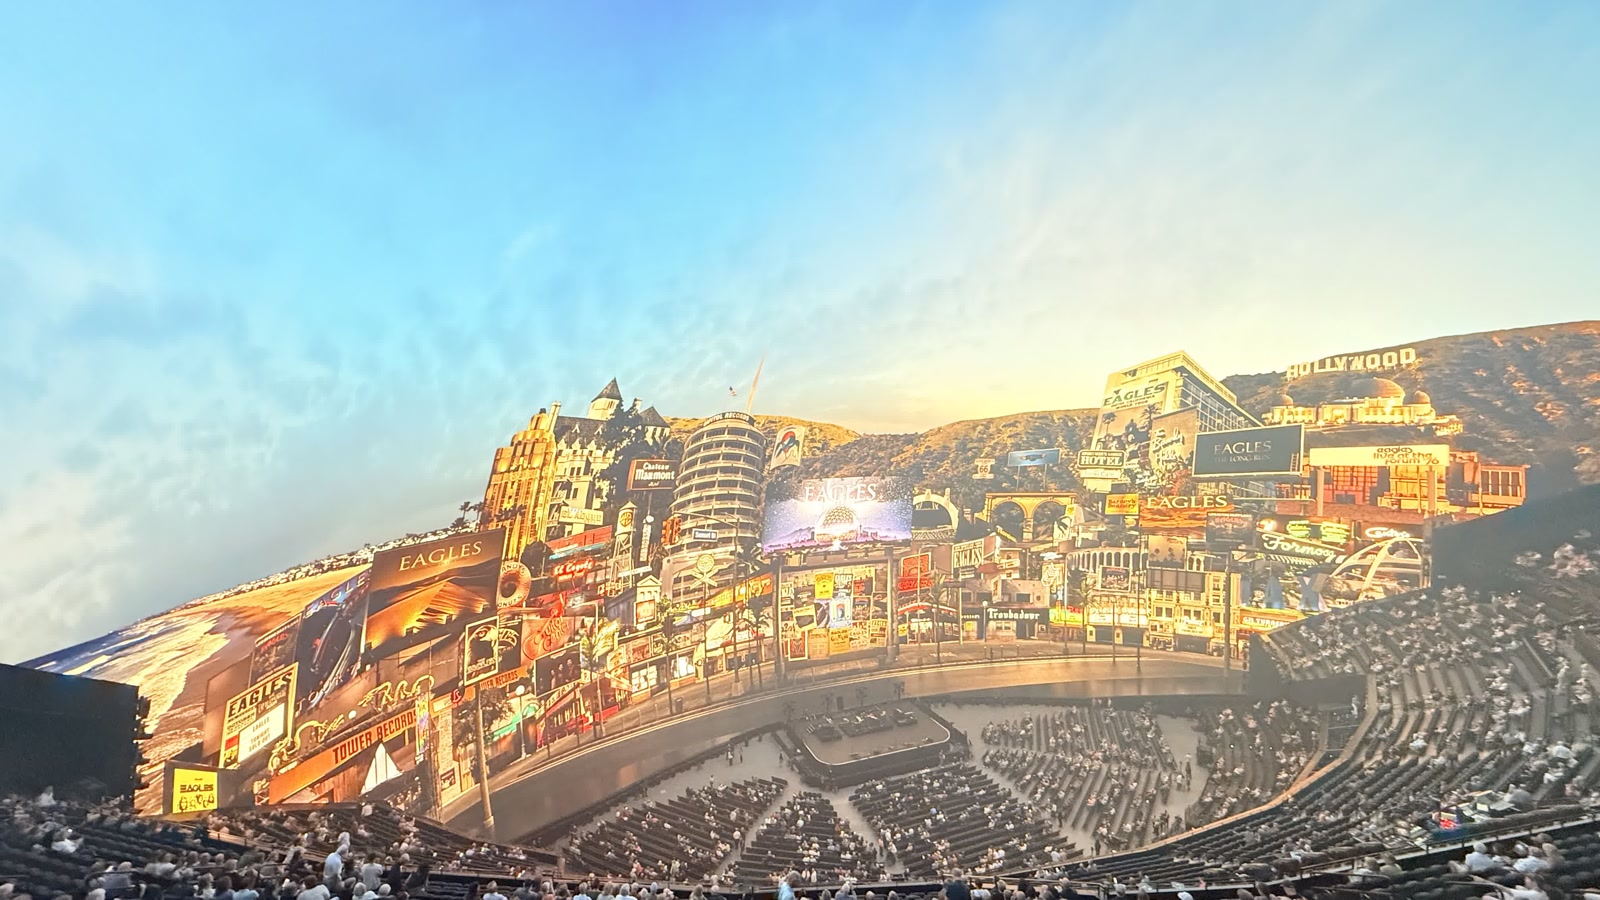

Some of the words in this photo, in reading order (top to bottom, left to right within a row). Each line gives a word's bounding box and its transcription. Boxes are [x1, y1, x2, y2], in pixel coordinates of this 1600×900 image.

[1286, 347, 1416, 379] HOLLYWOOD
[1103, 383, 1165, 407] EAGLES
[1214, 441, 1272, 455] EAGLES
[1080, 456, 1122, 465] HOTEL
[1229, 454, 1252, 462] LONG
[643, 462, 670, 470] Chateau
[979, 465, 988, 473] 66
[635, 469, 675, 480] Marmont
[805, 483, 878, 501] EAGLES
[1147, 495, 1228, 508] EAGLES
[398, 541, 482, 571] EAGLES
[501, 563, 525, 574] ANDY'S
[554, 564, 563, 574] El
[303, 571, 371, 619] EAGLE
[497, 595, 522, 608] ONUTS
[986, 608, 1041, 620] Troubadour
[495, 670, 518, 685] RECORDS
[228, 671, 293, 718] EAGLES
[332, 731, 372, 764] TOWER
[376, 708, 417, 742] RECORDS
[180, 784, 214, 793] EAGLES
